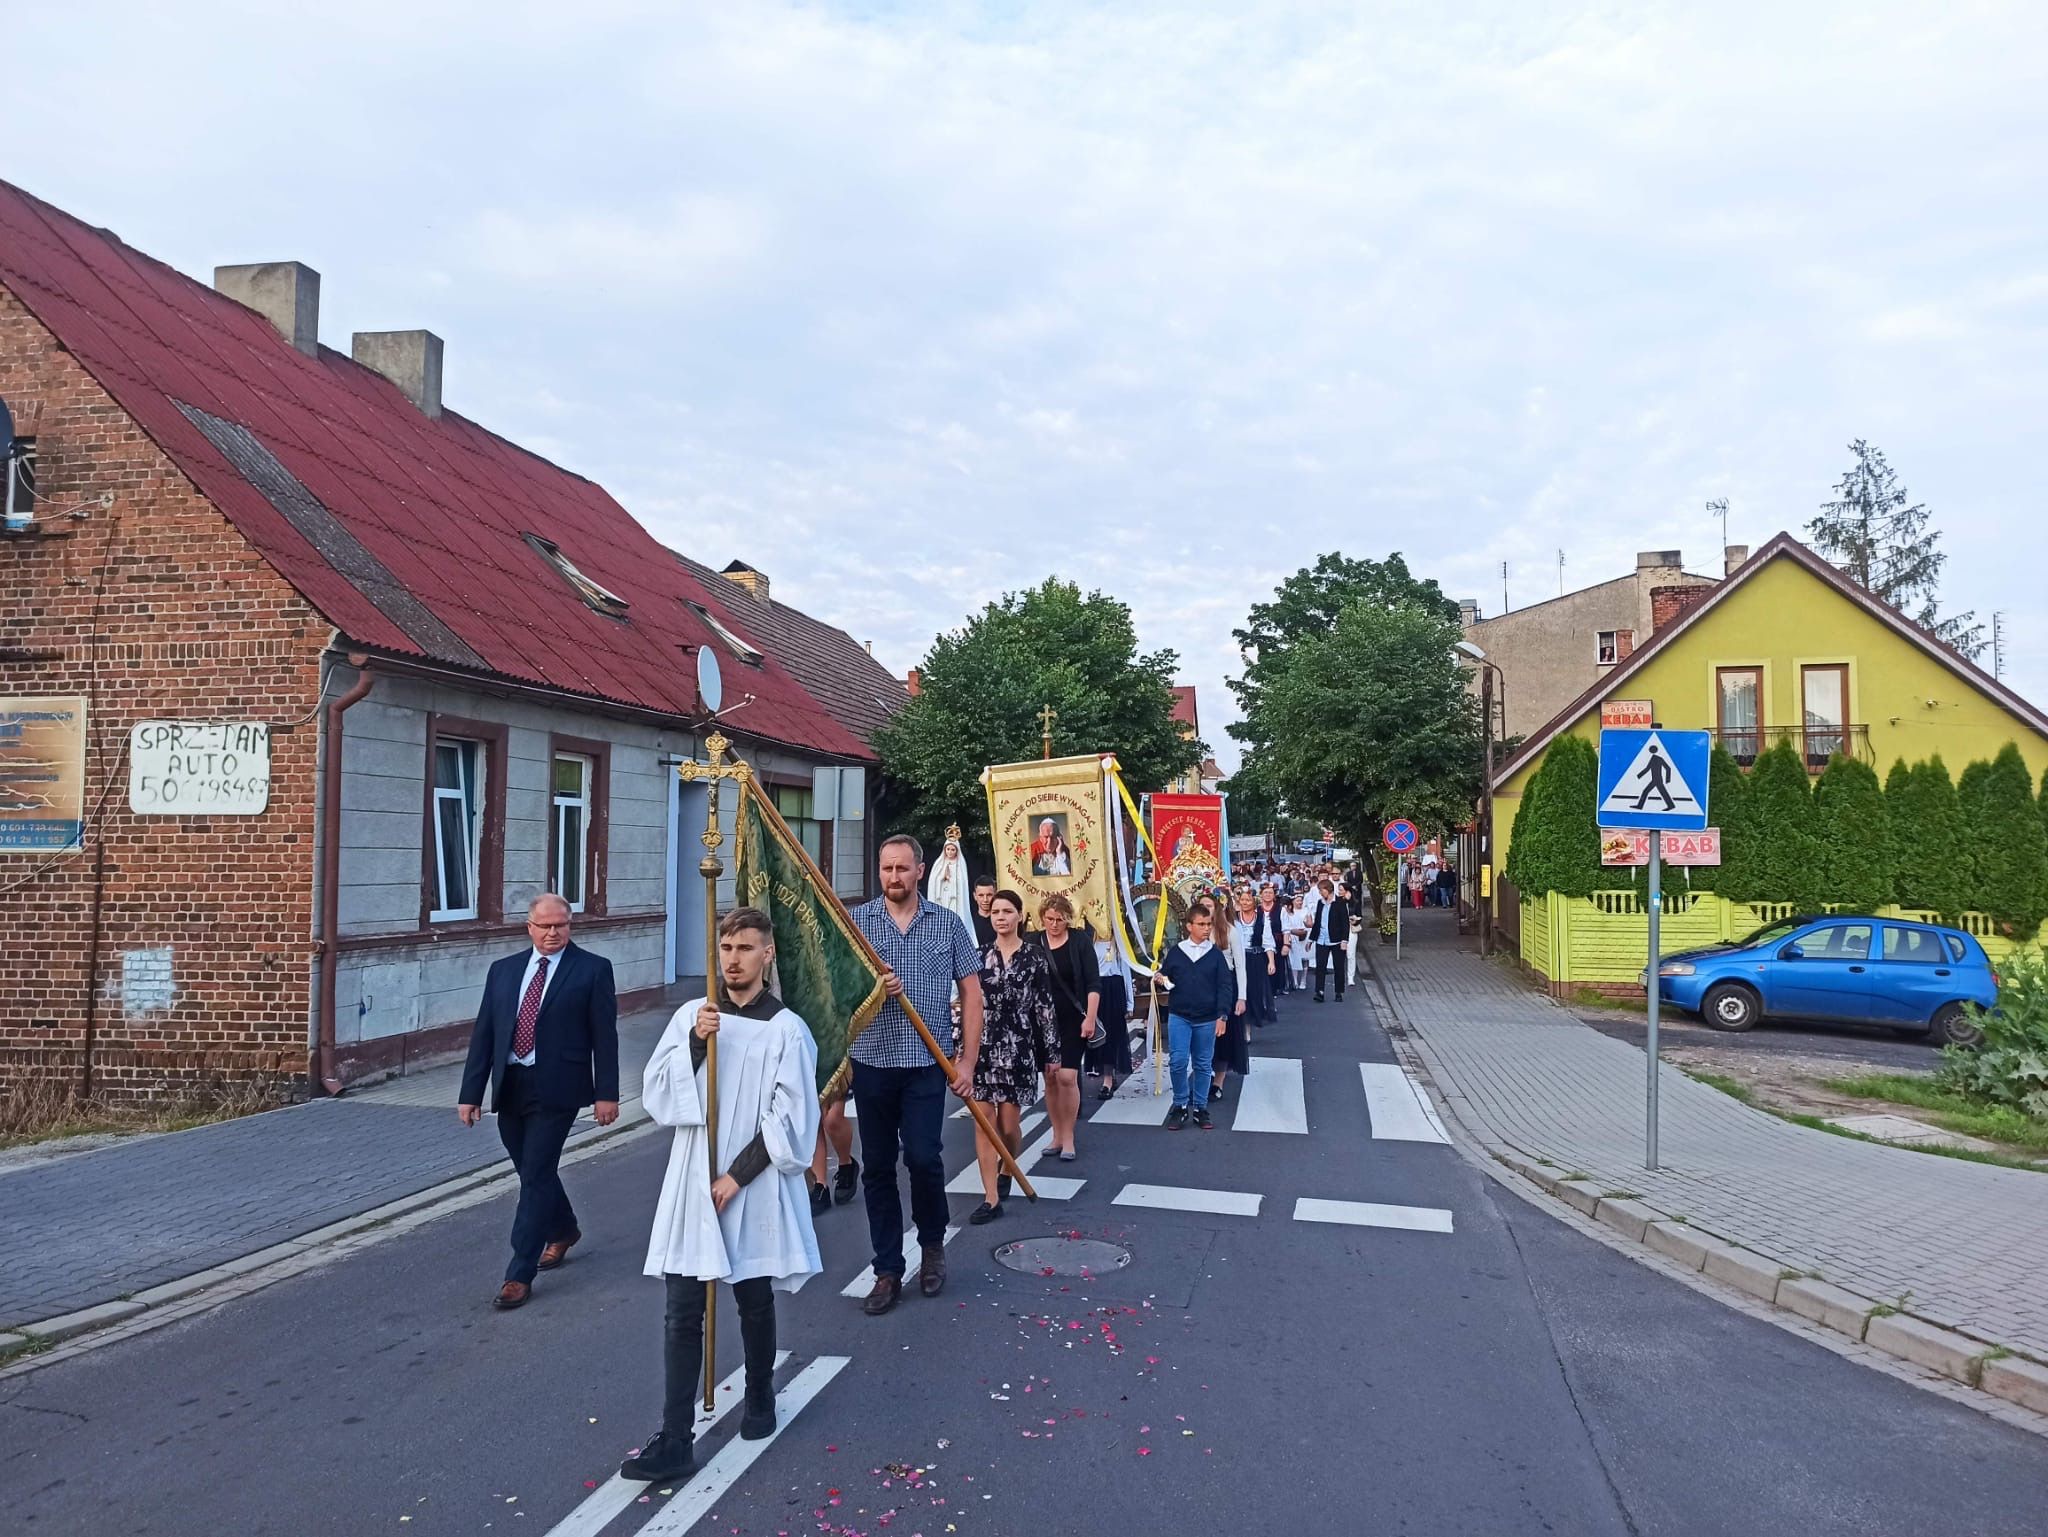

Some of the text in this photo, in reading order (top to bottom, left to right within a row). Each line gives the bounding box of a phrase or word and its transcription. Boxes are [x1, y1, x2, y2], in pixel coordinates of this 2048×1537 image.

[1602, 714, 1652, 725] KEBAB
[137, 724, 270, 759] SPRZEDAM
[168, 753, 238, 776] AUTO
[1004, 804, 1025, 836] MUSICIE
[1025, 796, 1037, 808] OD
[1037, 793, 1060, 803] SIEBIE
